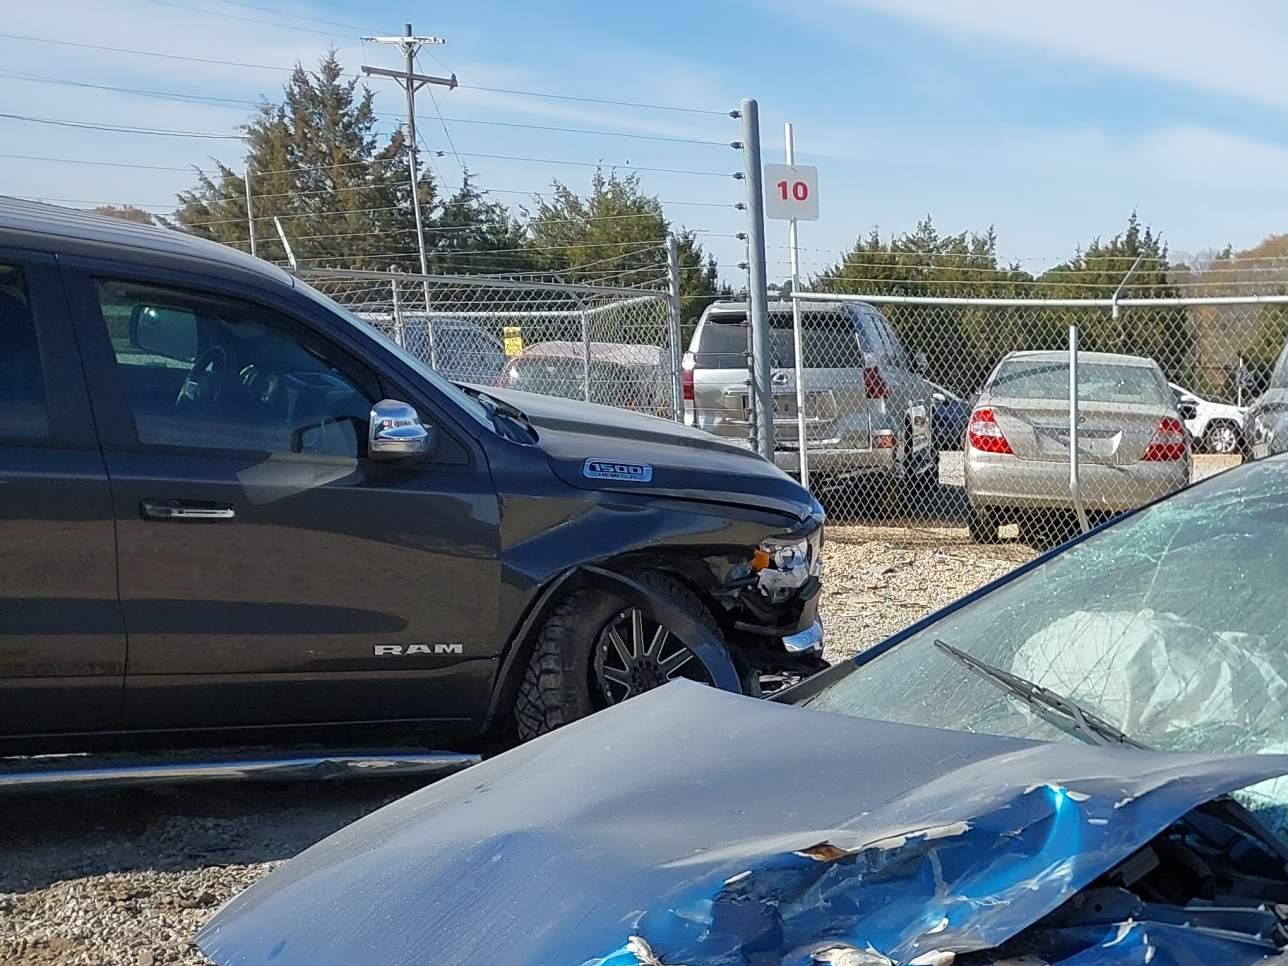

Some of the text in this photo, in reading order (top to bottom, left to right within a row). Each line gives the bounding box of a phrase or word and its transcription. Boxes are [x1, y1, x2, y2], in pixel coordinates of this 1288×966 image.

[777, 180, 808, 201] 10
[590, 462, 642, 475] 1500
[374, 643, 463, 656] RAM
